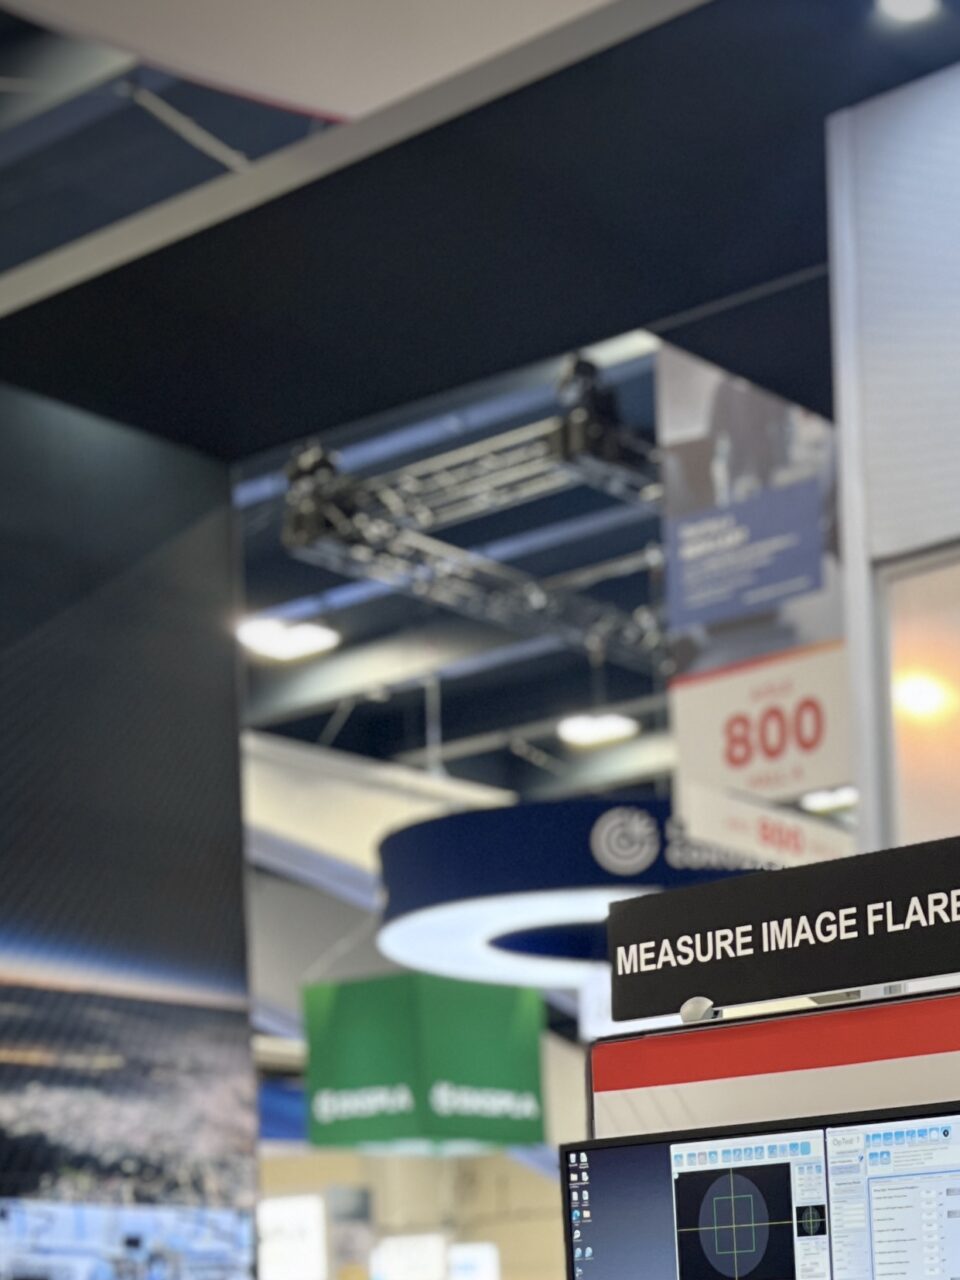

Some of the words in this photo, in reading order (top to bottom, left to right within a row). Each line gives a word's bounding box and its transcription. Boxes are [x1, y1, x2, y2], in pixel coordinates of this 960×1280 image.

[723, 698, 824, 768] 800
[616, 924, 754, 975] MEASURE
[761, 906, 859, 953] IMAGE
